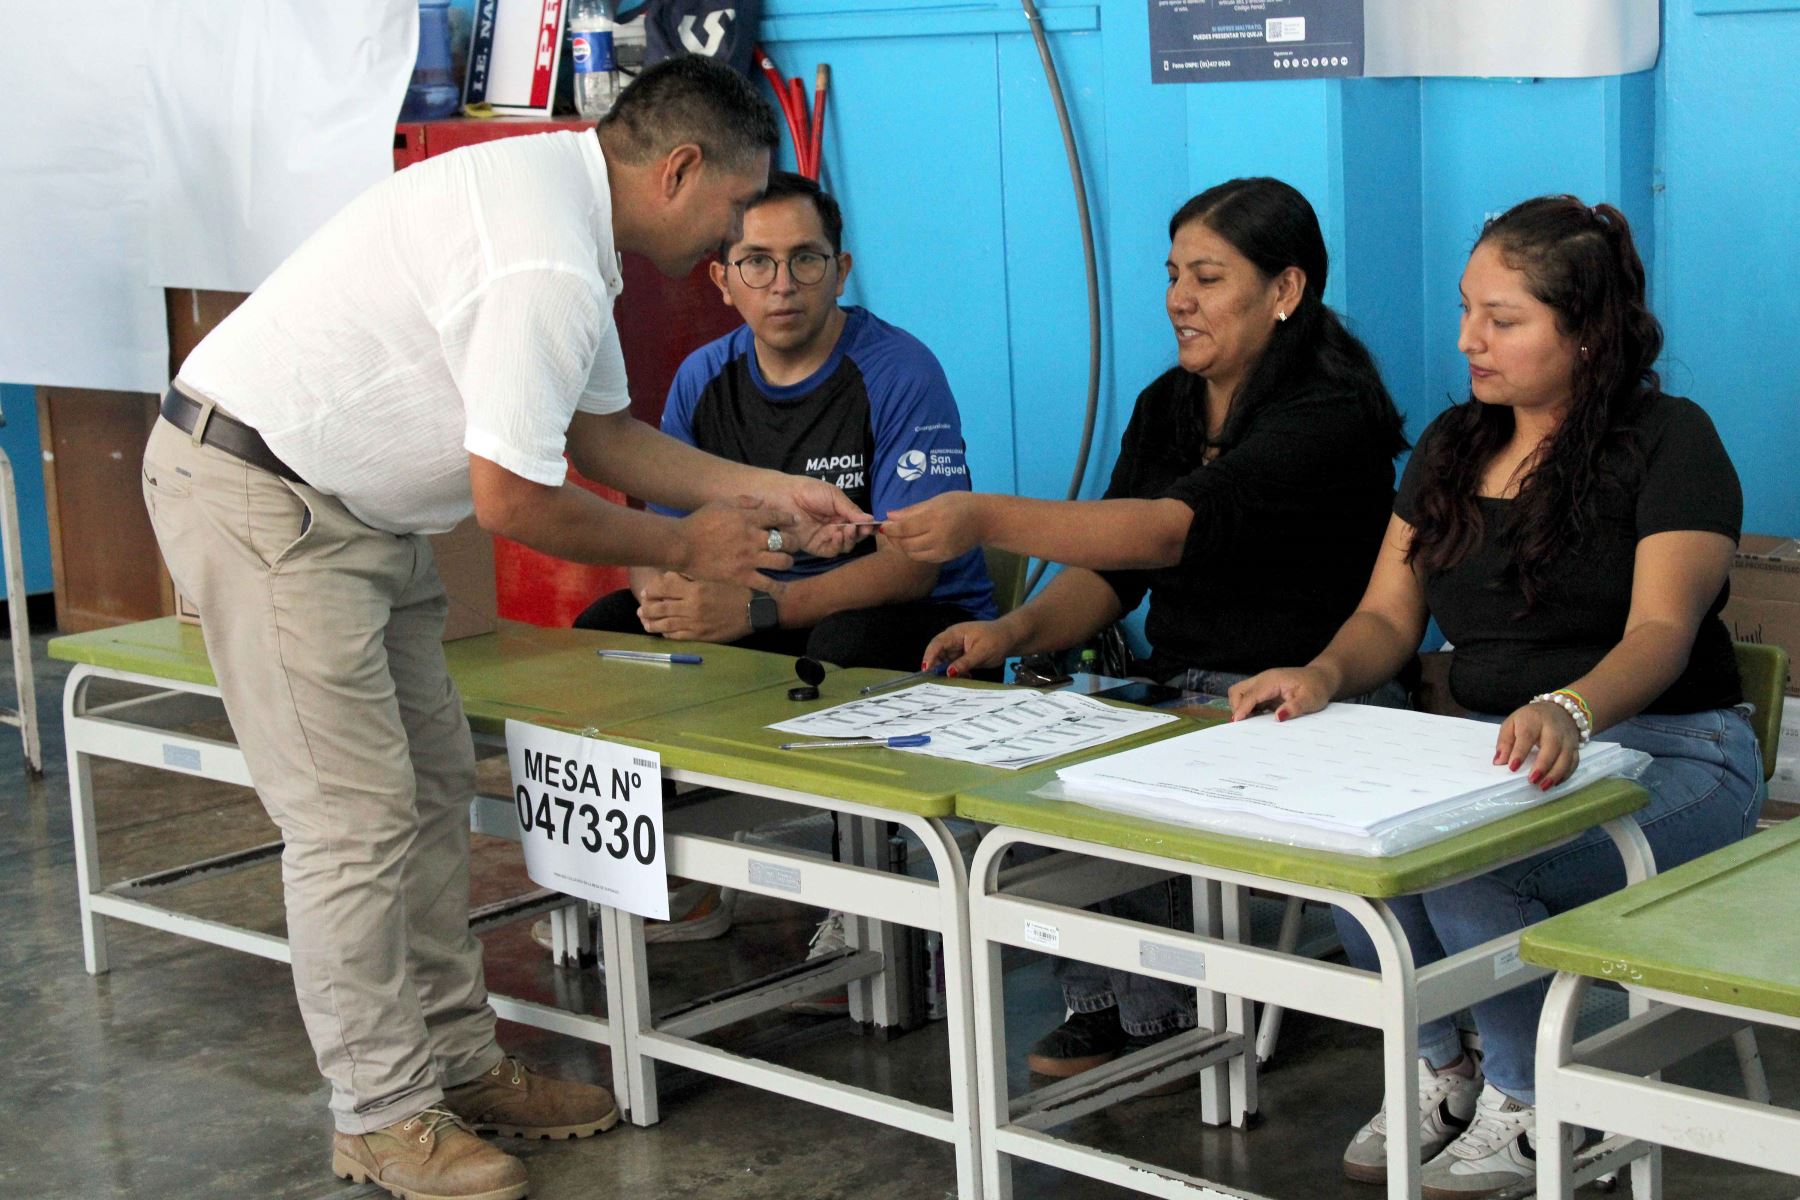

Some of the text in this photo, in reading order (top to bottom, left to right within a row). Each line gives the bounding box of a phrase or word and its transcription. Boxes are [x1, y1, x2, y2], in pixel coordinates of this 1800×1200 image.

[480, 0, 494, 38] NA
[930, 454, 952, 465] San
[930, 464, 967, 477] Miguel
[836, 471, 865, 490] 42K
[524, 748, 601, 797] MESA
[516, 784, 656, 865] 047330
